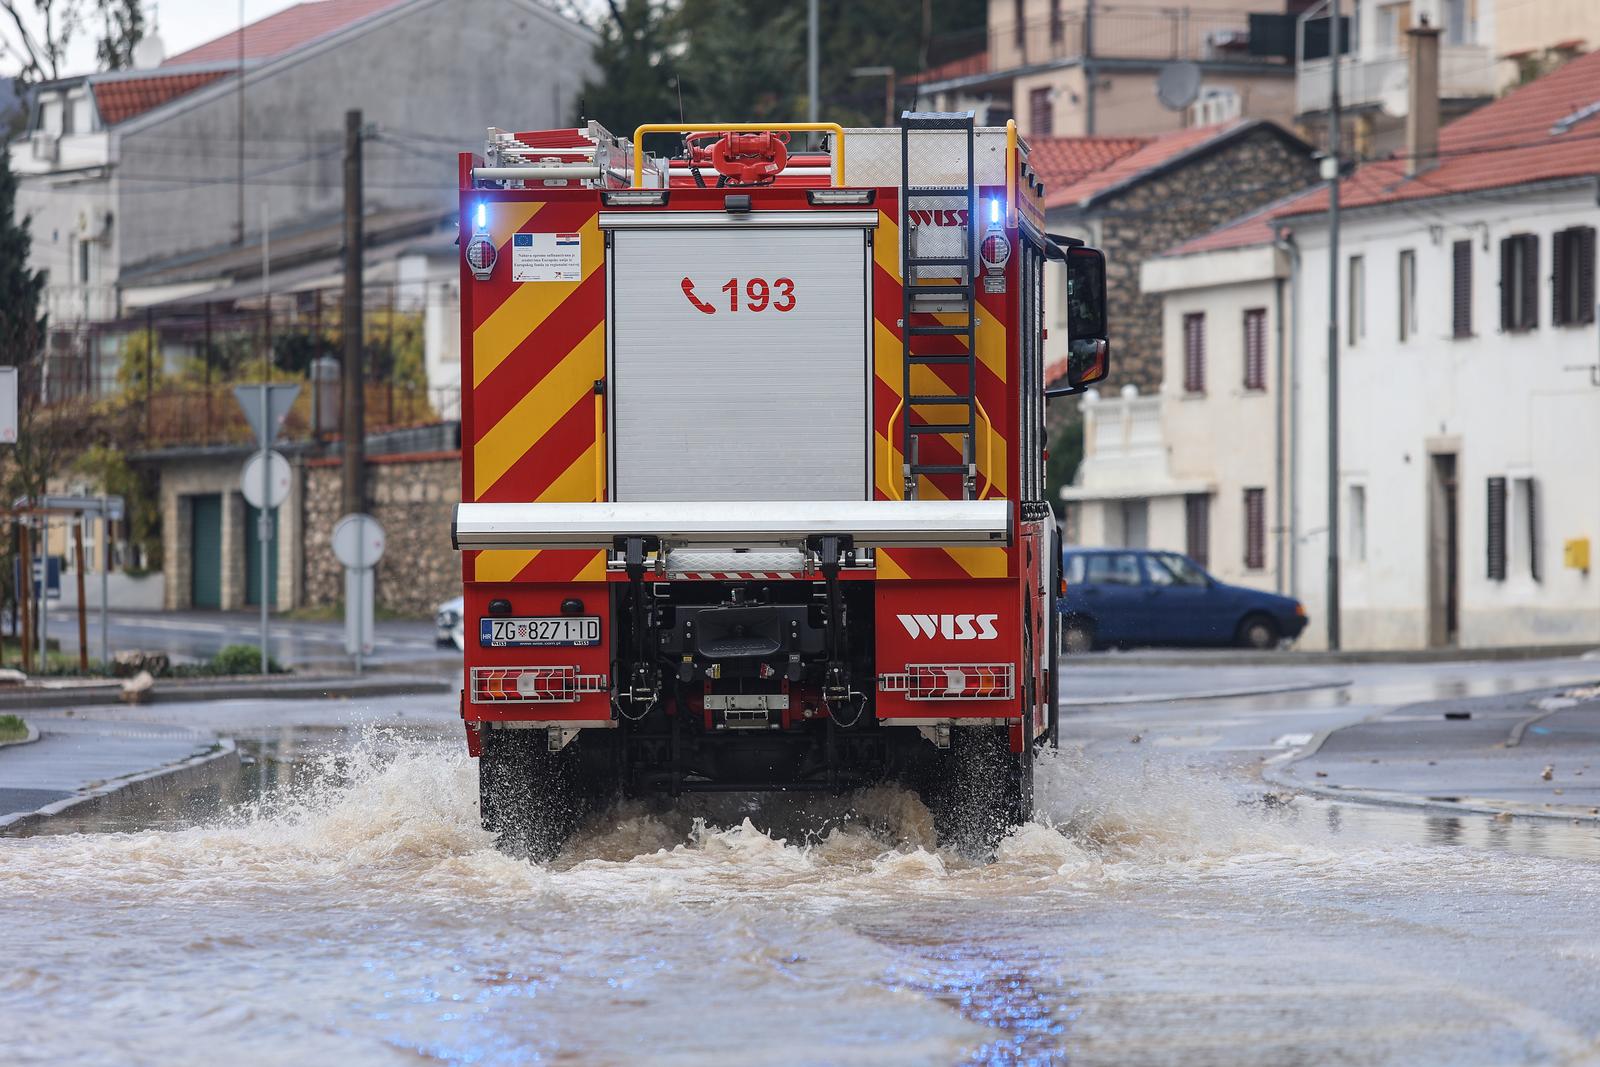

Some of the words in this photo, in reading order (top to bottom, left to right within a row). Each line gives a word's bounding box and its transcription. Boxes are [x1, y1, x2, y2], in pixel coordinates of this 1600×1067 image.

[908, 210, 968, 226] WISS
[722, 277, 796, 312] 193
[494, 621, 516, 640] ZG
[896, 614, 998, 640] WISS
